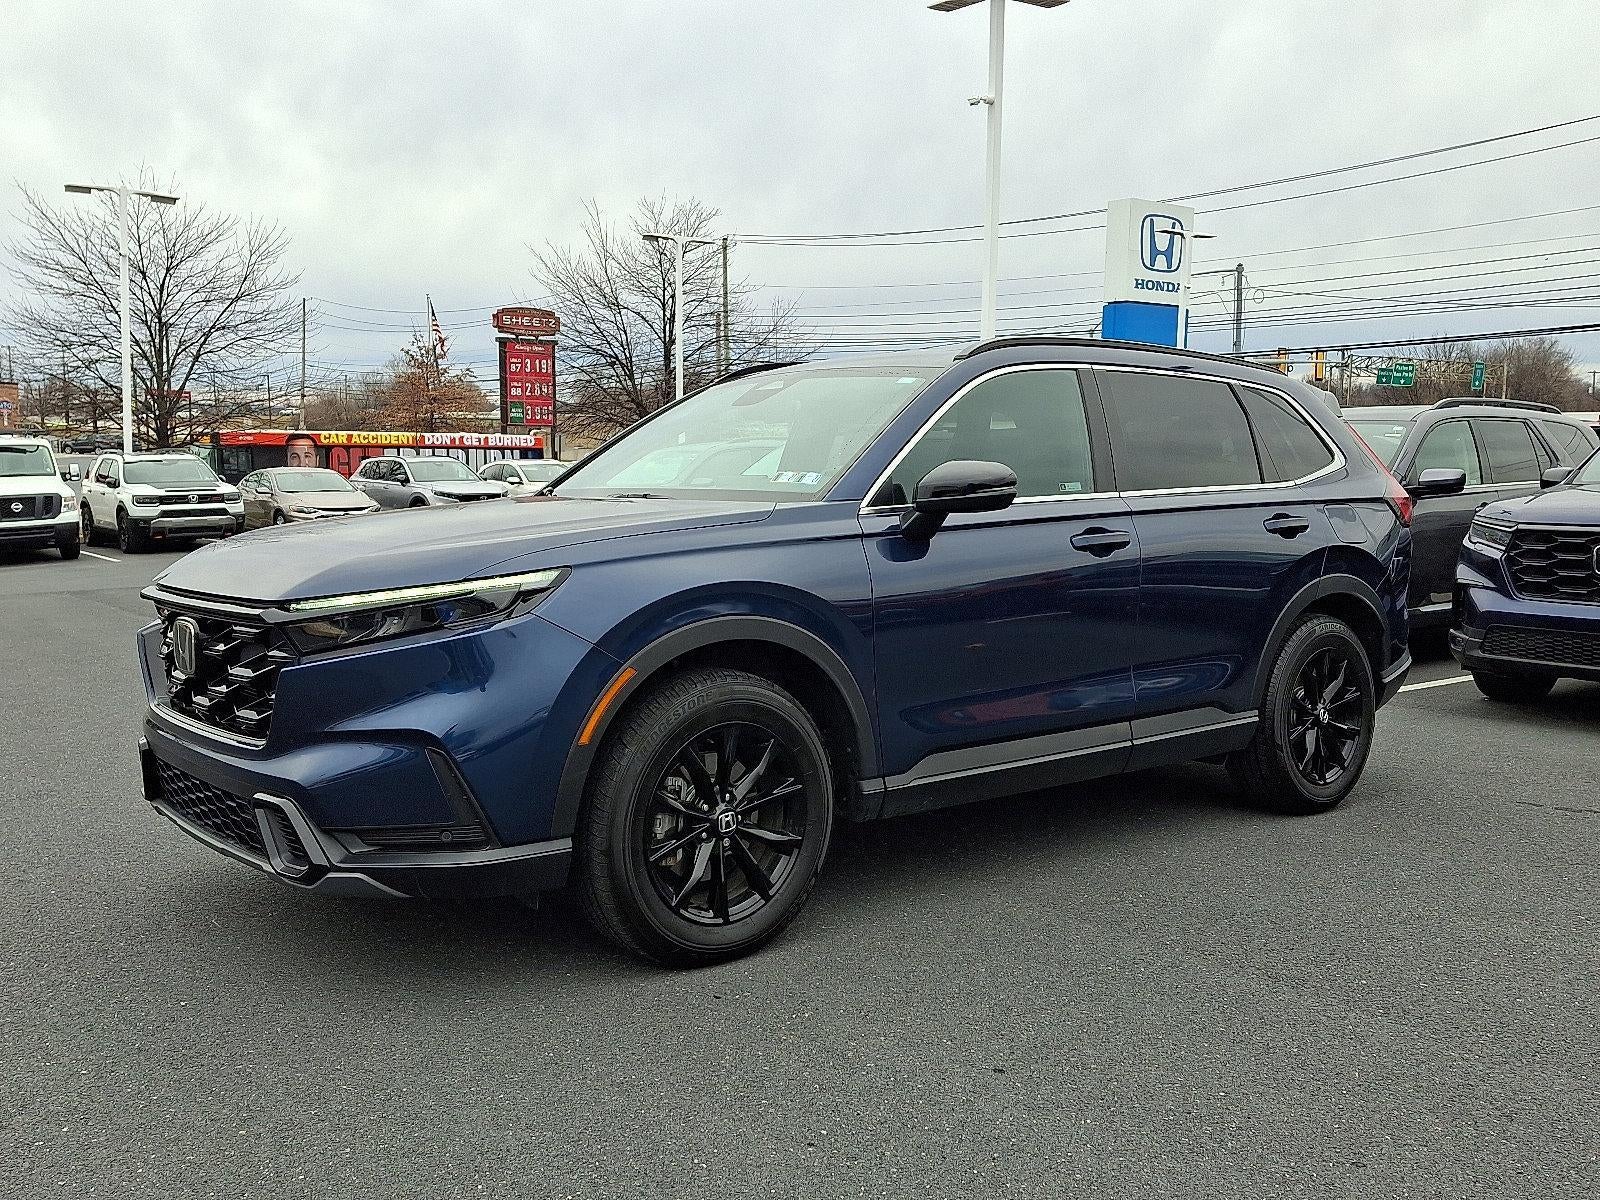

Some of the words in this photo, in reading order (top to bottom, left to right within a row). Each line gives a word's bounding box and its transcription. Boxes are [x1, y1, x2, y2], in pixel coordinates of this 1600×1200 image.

[503, 316, 556, 328] SHEETZ
[510, 364, 521, 372] 87
[511, 387, 522, 396] 88
[320, 433, 348, 444] CAR
[424, 434, 460, 445] DON'T
[462, 435, 486, 446] GET
[488, 436, 535, 447] BURNED
